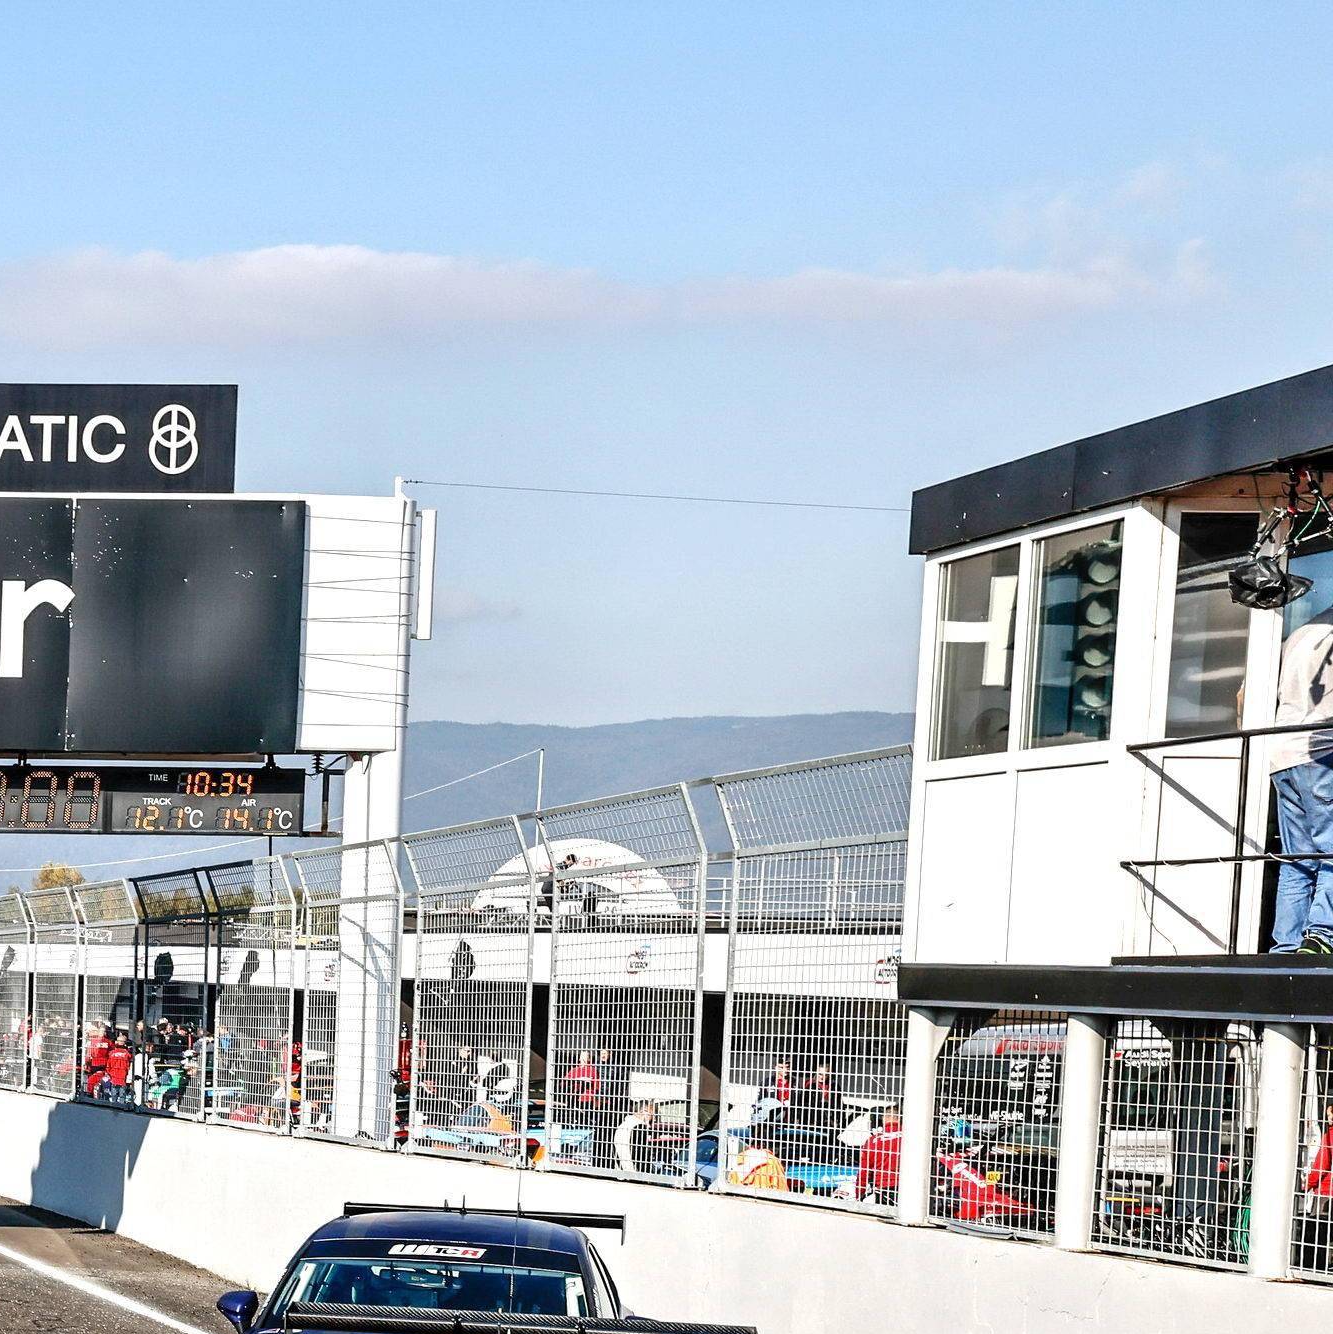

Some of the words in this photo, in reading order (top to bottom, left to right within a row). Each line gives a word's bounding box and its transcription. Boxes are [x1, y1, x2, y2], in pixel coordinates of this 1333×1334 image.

[148, 773, 169, 782] TIME
[142, 797, 172, 806] TRACK
[241, 798, 257, 807] AIR
[387, 1243, 488, 1259] WTCR
